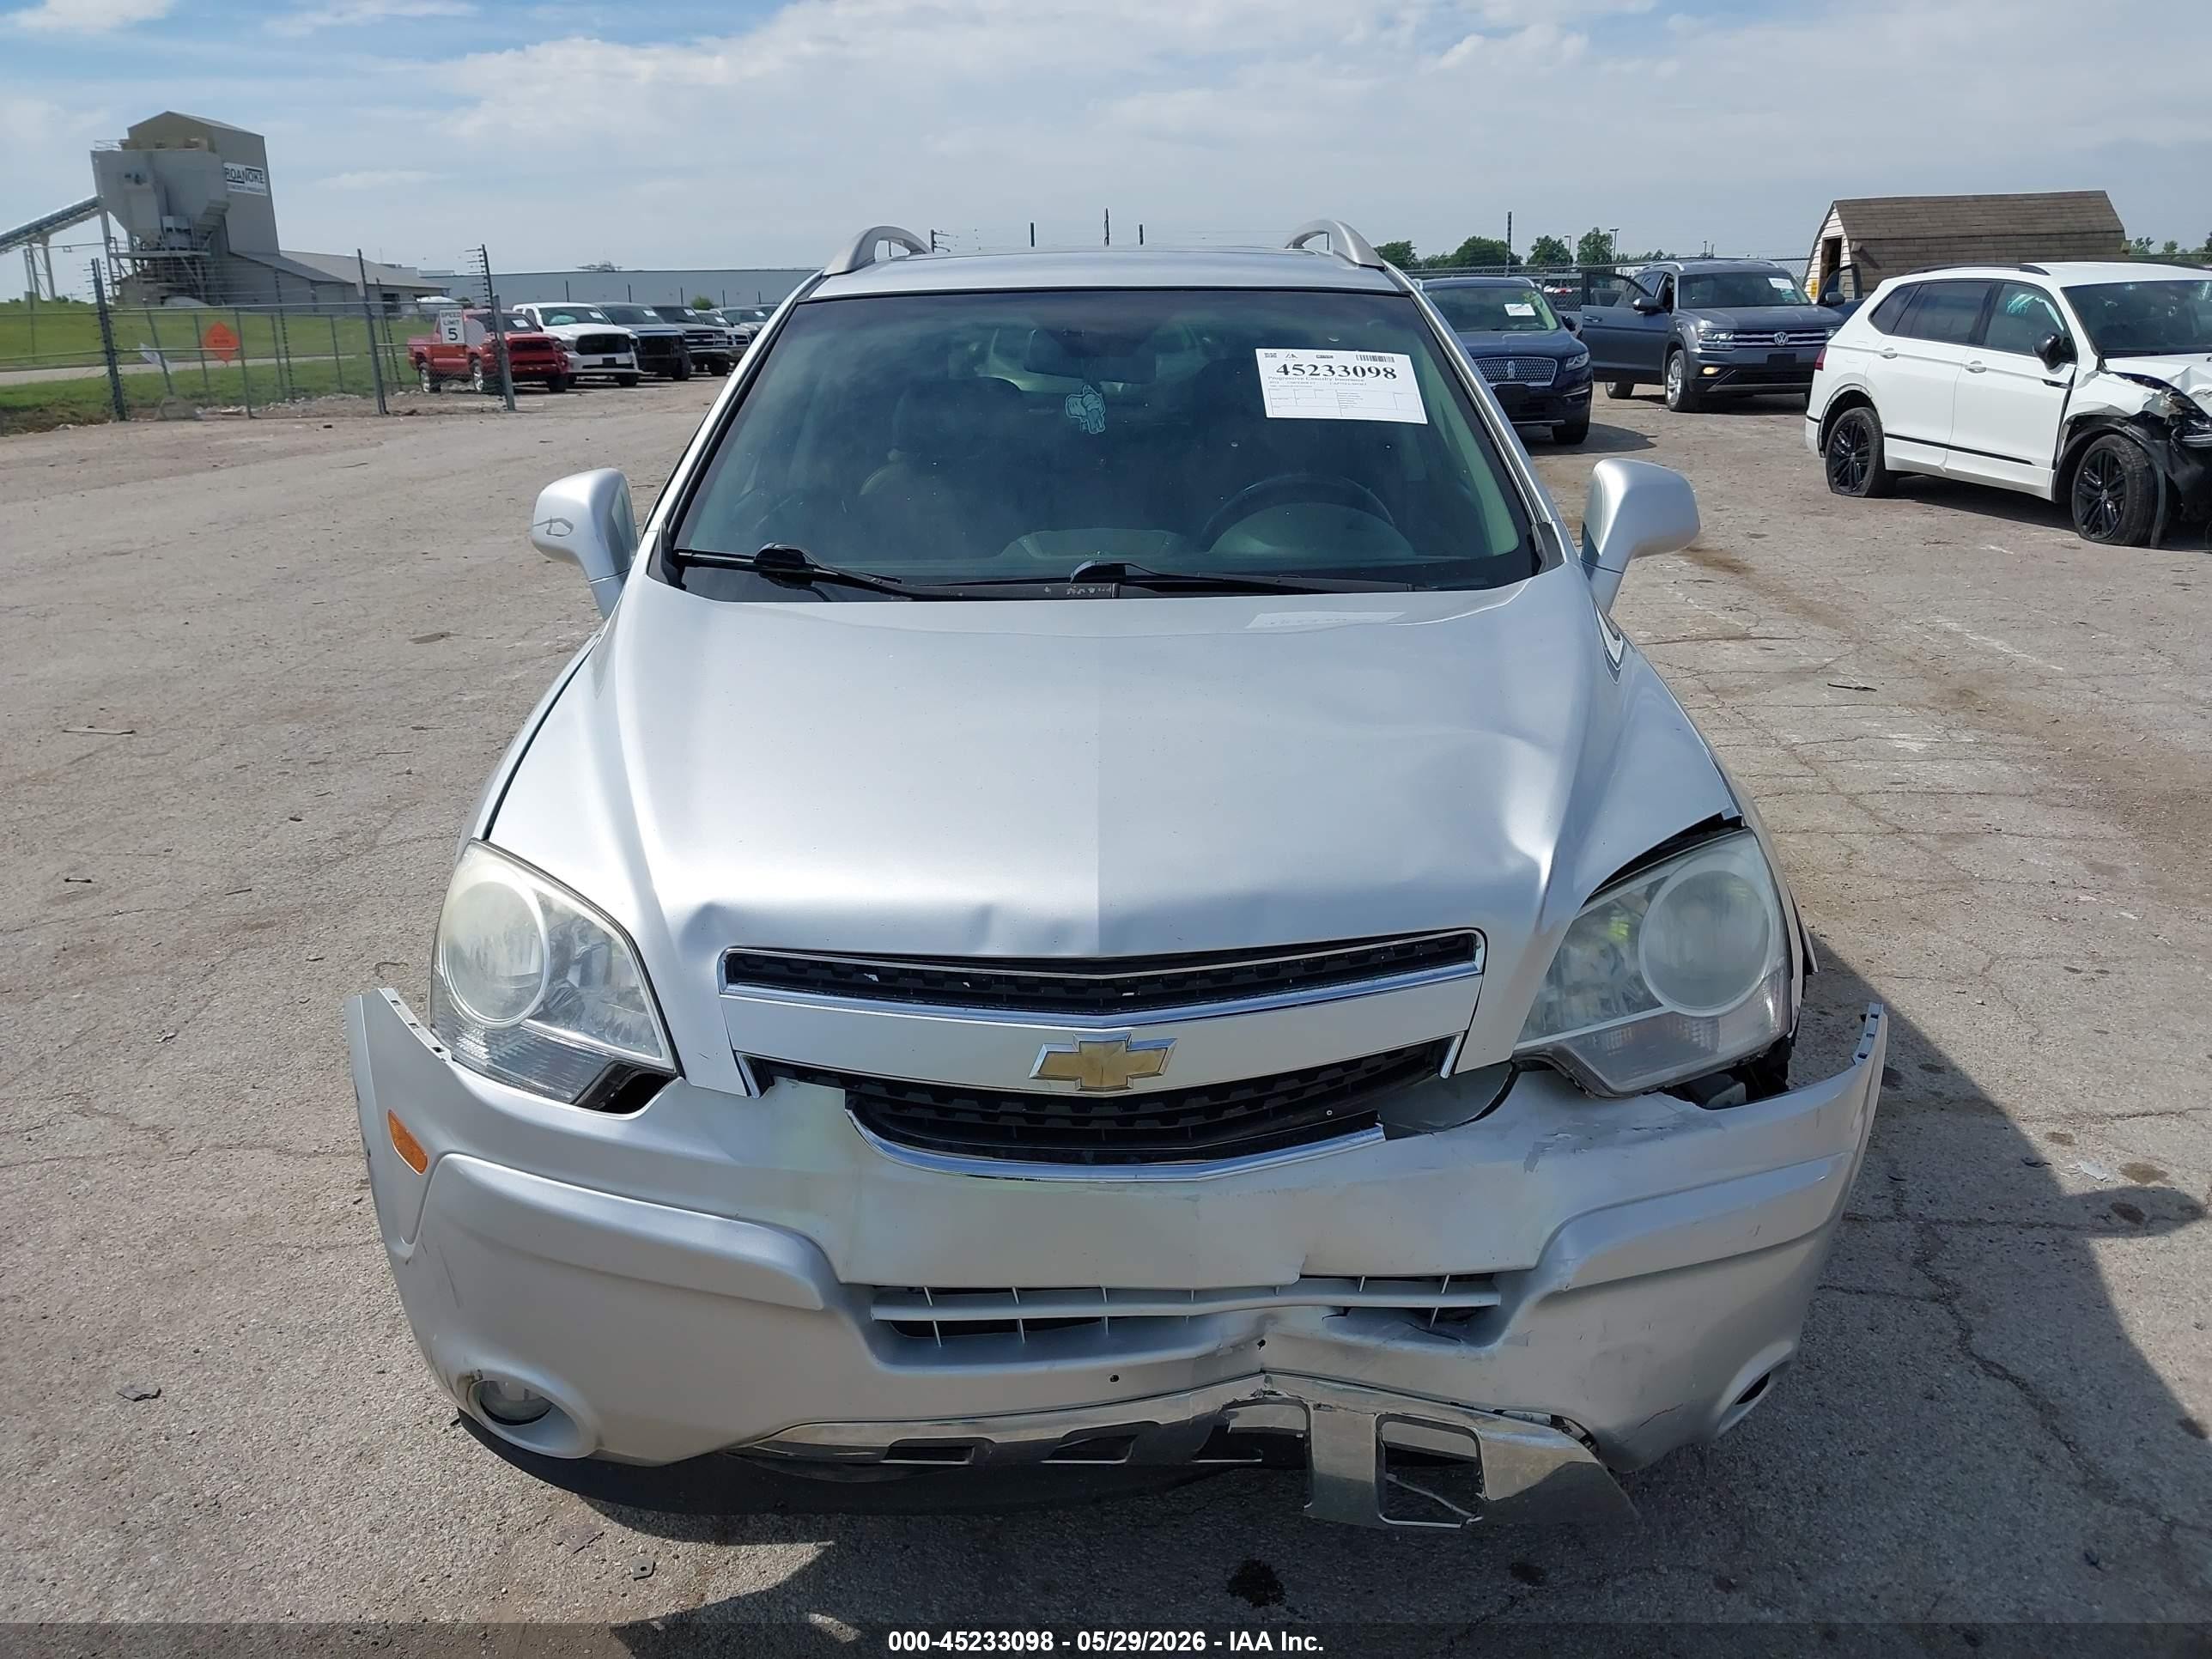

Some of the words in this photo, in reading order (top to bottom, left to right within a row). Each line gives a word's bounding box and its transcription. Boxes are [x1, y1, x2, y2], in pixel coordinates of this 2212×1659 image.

[224, 167, 264, 184] ROANOKE
[448, 328, 459, 341] 5
[1276, 363, 1397, 380] 45233098
